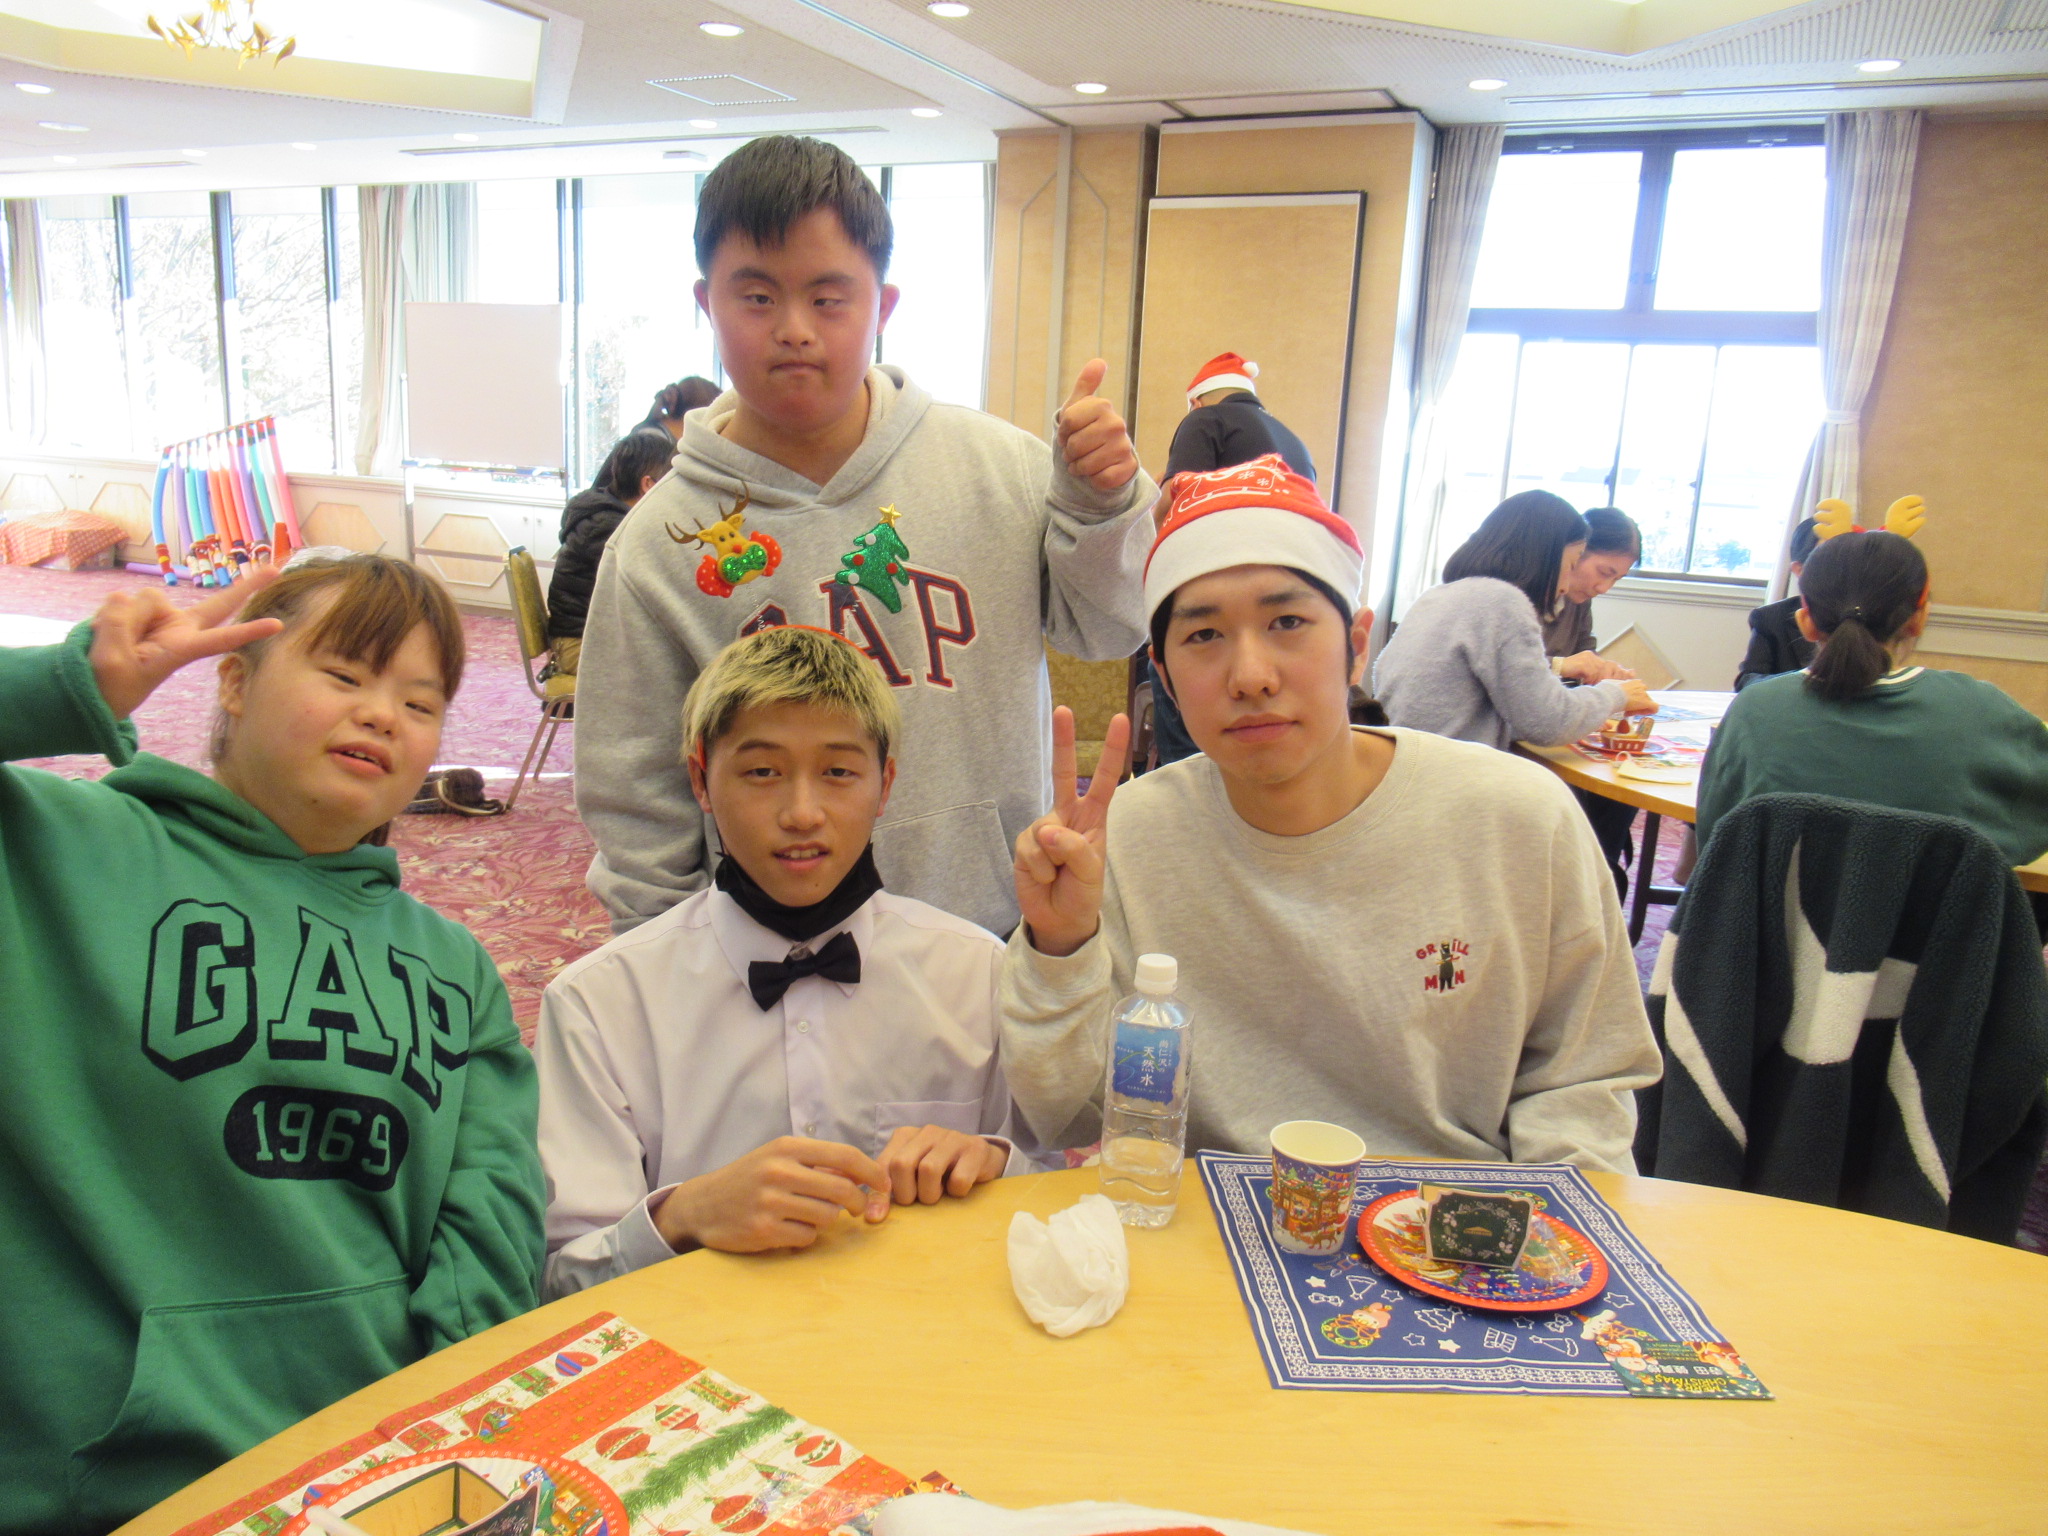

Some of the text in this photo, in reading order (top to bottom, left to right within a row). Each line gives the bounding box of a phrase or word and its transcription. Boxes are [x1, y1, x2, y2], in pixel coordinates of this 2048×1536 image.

[737, 559, 978, 692] AP
[141, 898, 473, 1113] GAP
[1139, 1046, 1155, 1087] 天然水
[252, 1100, 391, 1176] 1969
[1654, 1373, 1727, 1388] CHRISTMAS
